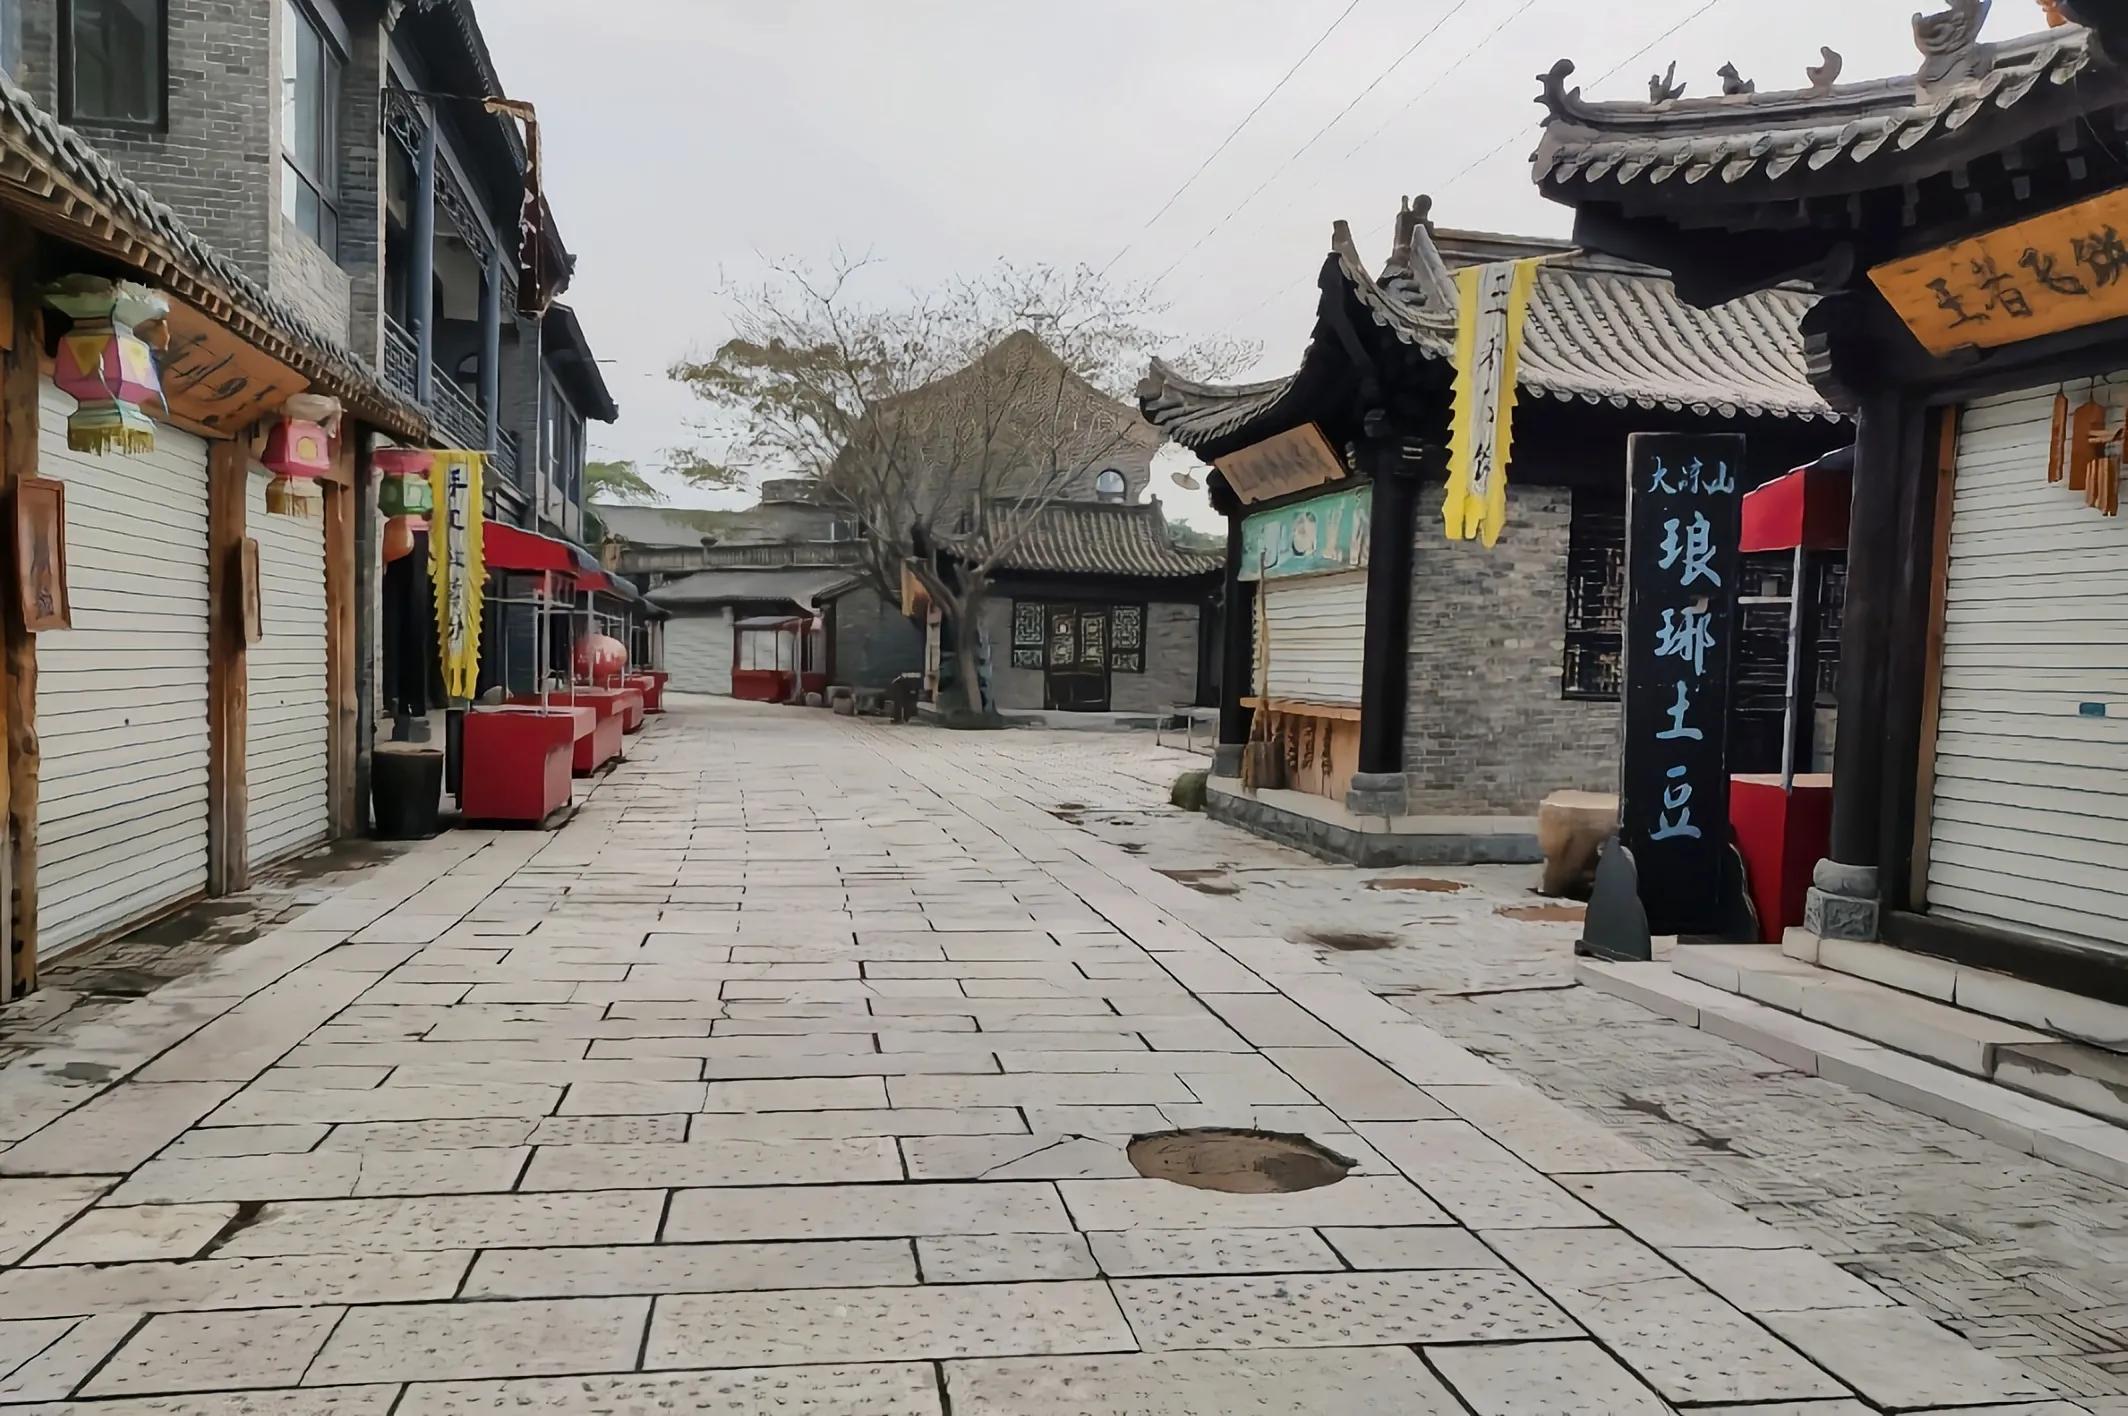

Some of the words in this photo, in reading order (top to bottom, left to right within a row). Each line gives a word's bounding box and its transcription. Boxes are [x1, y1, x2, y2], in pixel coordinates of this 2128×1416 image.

[1648, 456, 1735, 495] 大凉山
[1650, 510, 1722, 841] 琅琊土豆
